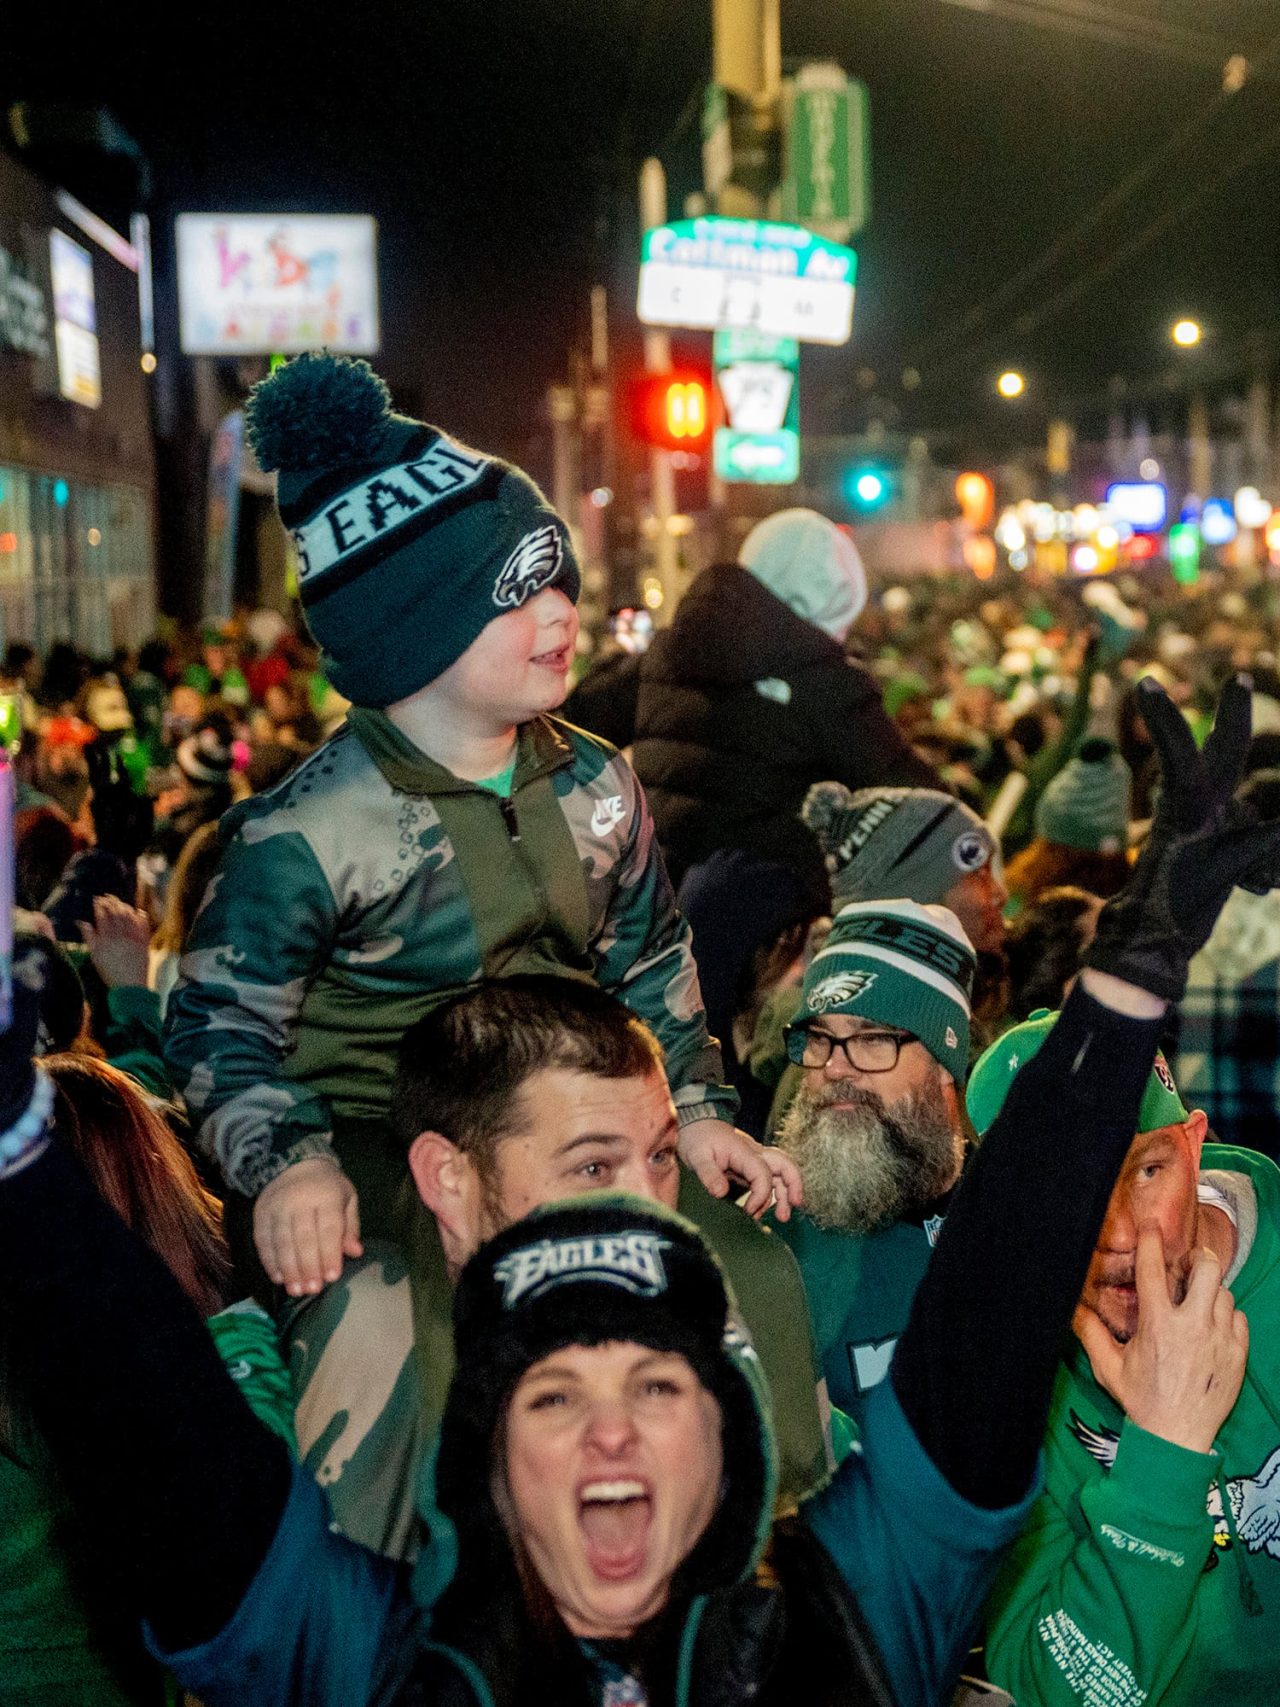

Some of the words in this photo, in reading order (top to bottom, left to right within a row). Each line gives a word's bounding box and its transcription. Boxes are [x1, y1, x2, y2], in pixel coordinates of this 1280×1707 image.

[594, 794, 626, 822] NIKE
[494, 1230, 673, 1309] EAGLES
[1048, 1644, 1069, 1670] NEW
[1075, 1647, 1091, 1667] THE
[1065, 1671, 1081, 1693] THE
[1089, 1665, 1103, 1678] OF
[1104, 1665, 1122, 1682] NEW
[1085, 1673, 1112, 1701] NAMED
[1100, 1674, 1127, 1702] HONOR
